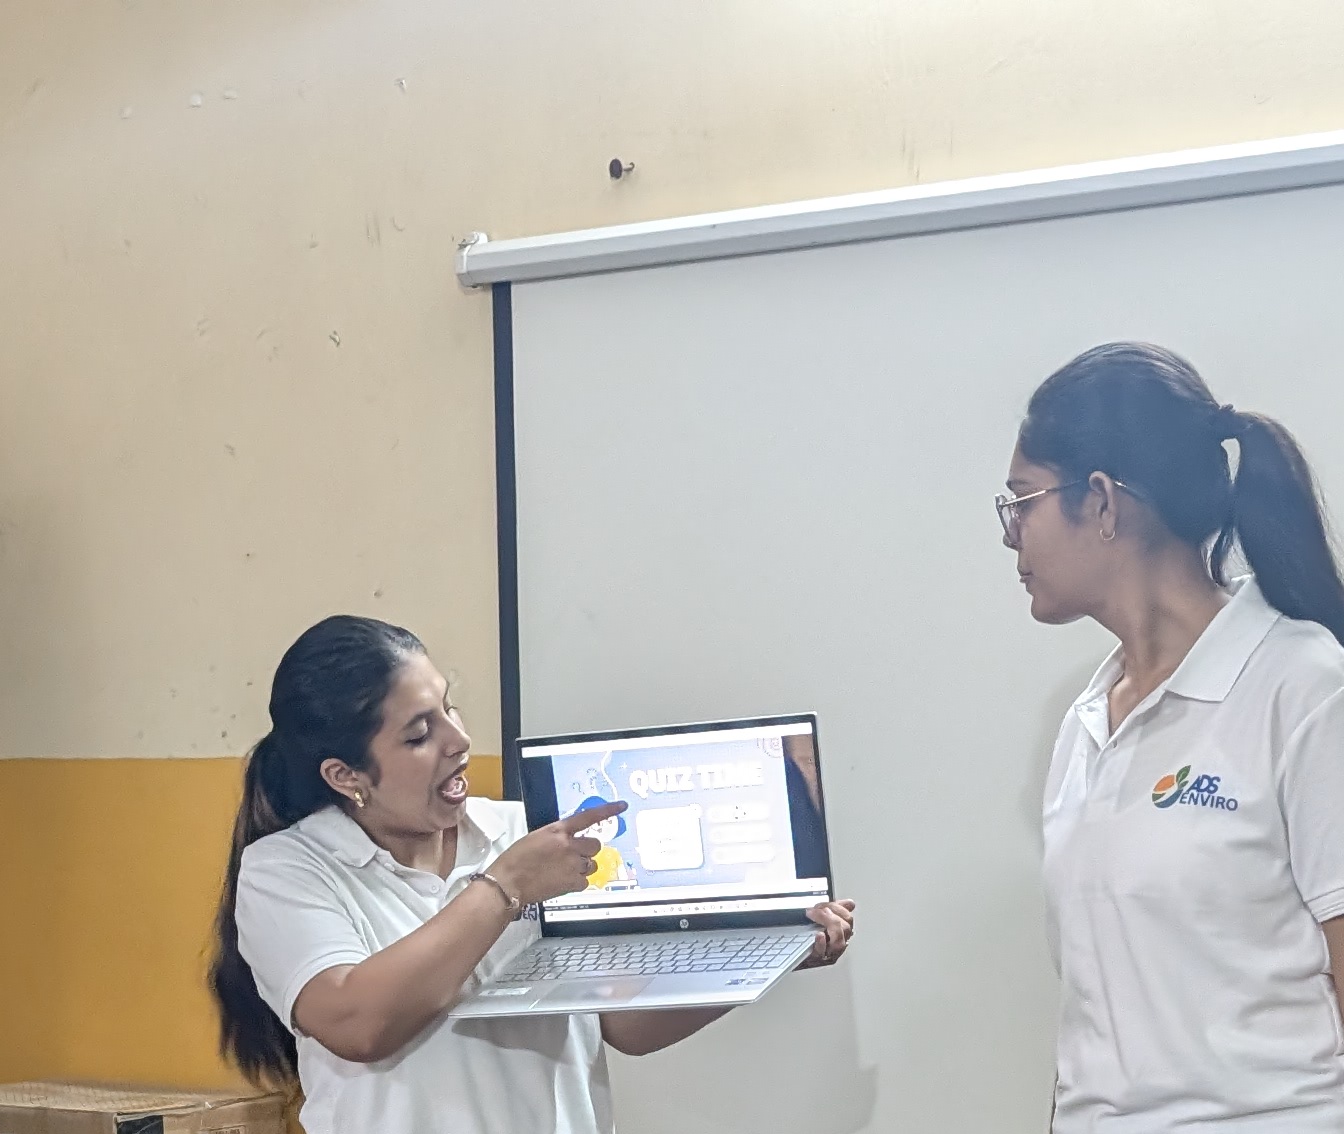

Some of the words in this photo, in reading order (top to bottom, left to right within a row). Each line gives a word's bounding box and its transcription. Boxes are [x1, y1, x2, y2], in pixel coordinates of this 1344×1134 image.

[629, 766, 695, 799] QUIZ
[1183, 774, 1221, 795] ADS
[1178, 792, 1238, 811] ENVIRO
